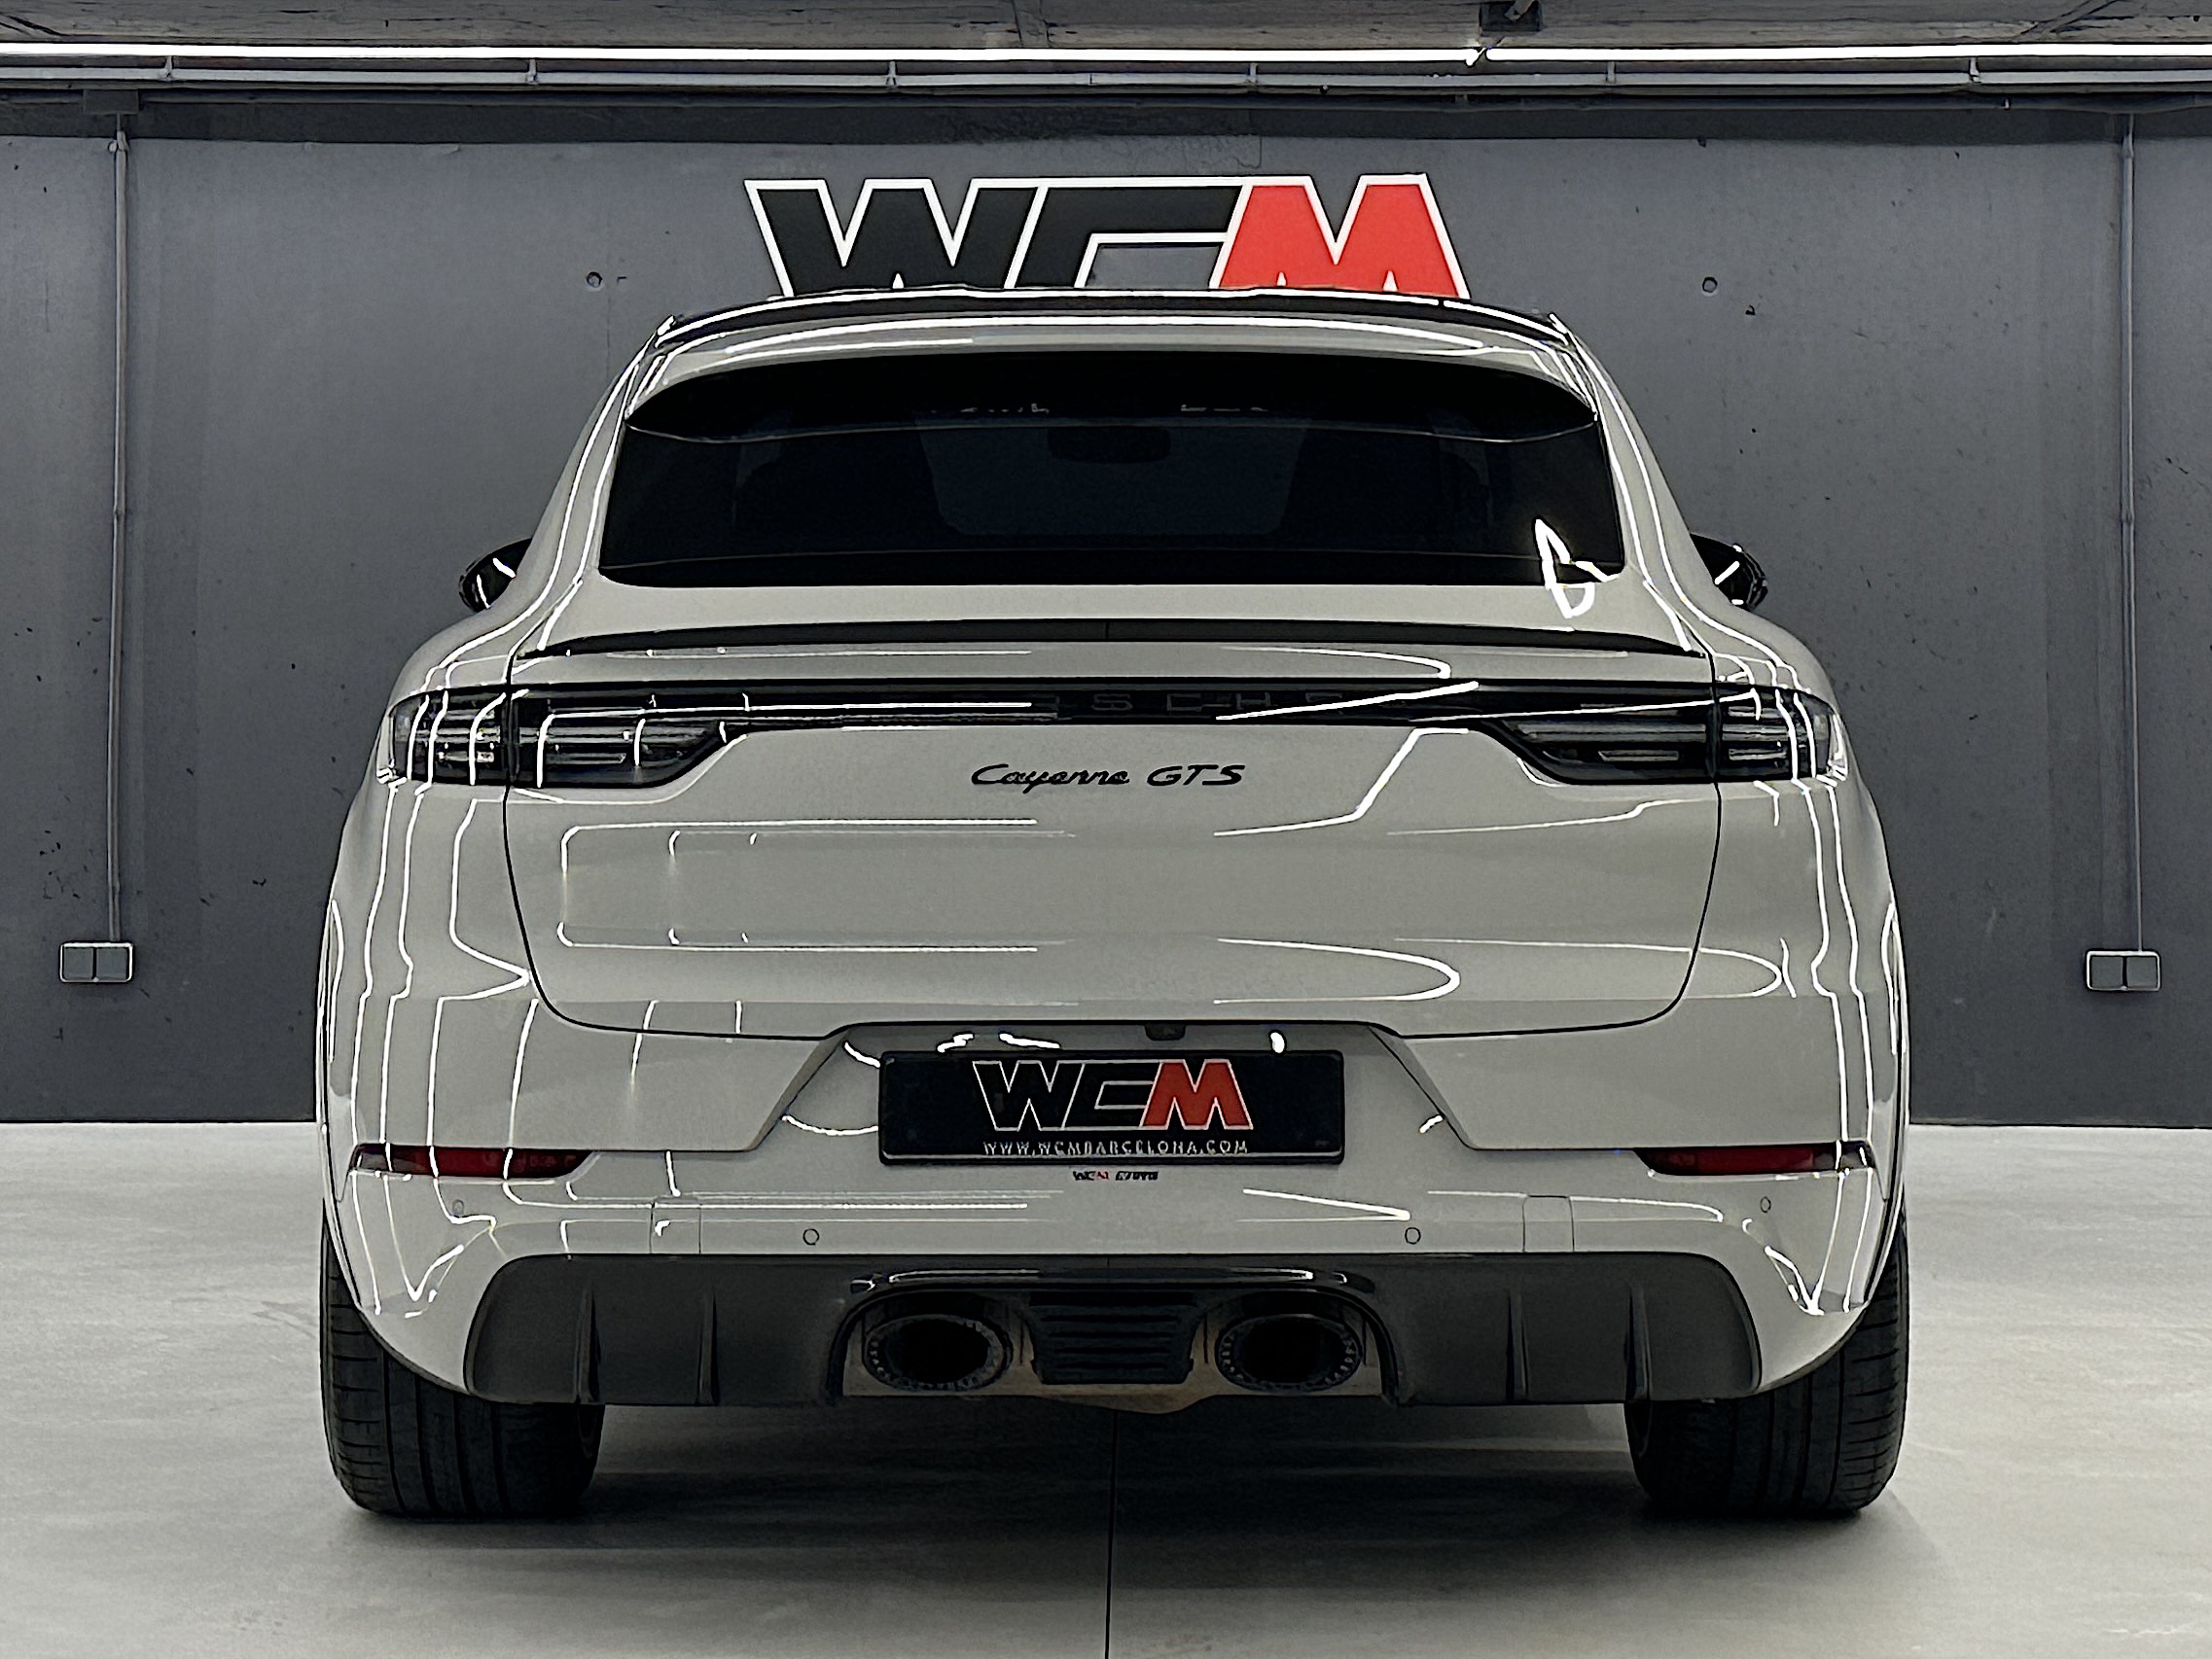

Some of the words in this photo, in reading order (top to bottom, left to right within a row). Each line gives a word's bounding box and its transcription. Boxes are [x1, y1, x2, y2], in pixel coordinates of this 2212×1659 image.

[744, 173, 1471, 300] WCM
[971, 763, 1130, 794] Cayenne
[1147, 764, 1246, 787] GTS
[972, 1059, 1254, 1132] WCM
